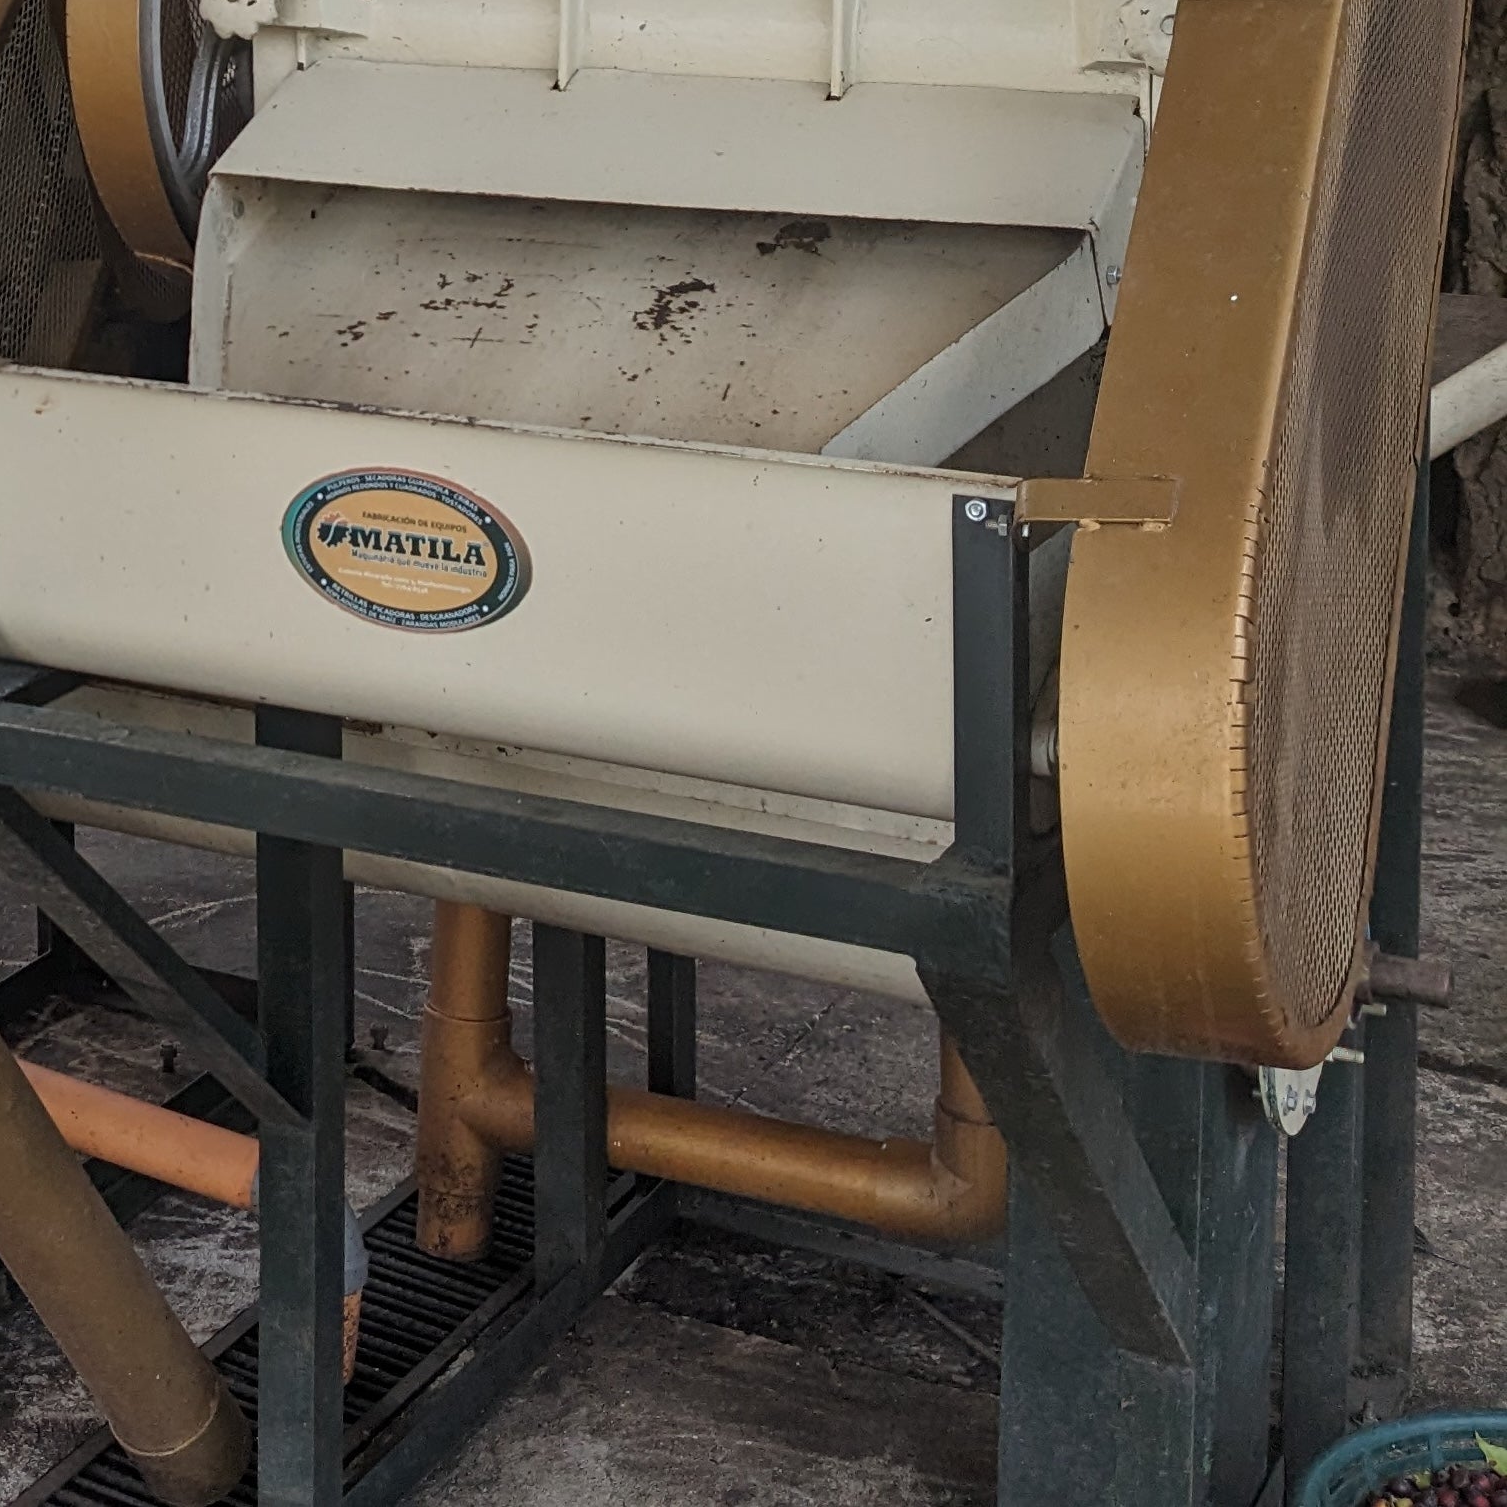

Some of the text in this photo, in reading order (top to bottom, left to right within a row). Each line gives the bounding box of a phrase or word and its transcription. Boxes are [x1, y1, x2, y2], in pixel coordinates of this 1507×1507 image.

[418, 519, 428, 528] DE
[430, 521, 467, 534] EQUIPOS
[348, 525, 486, 567] MATILA
